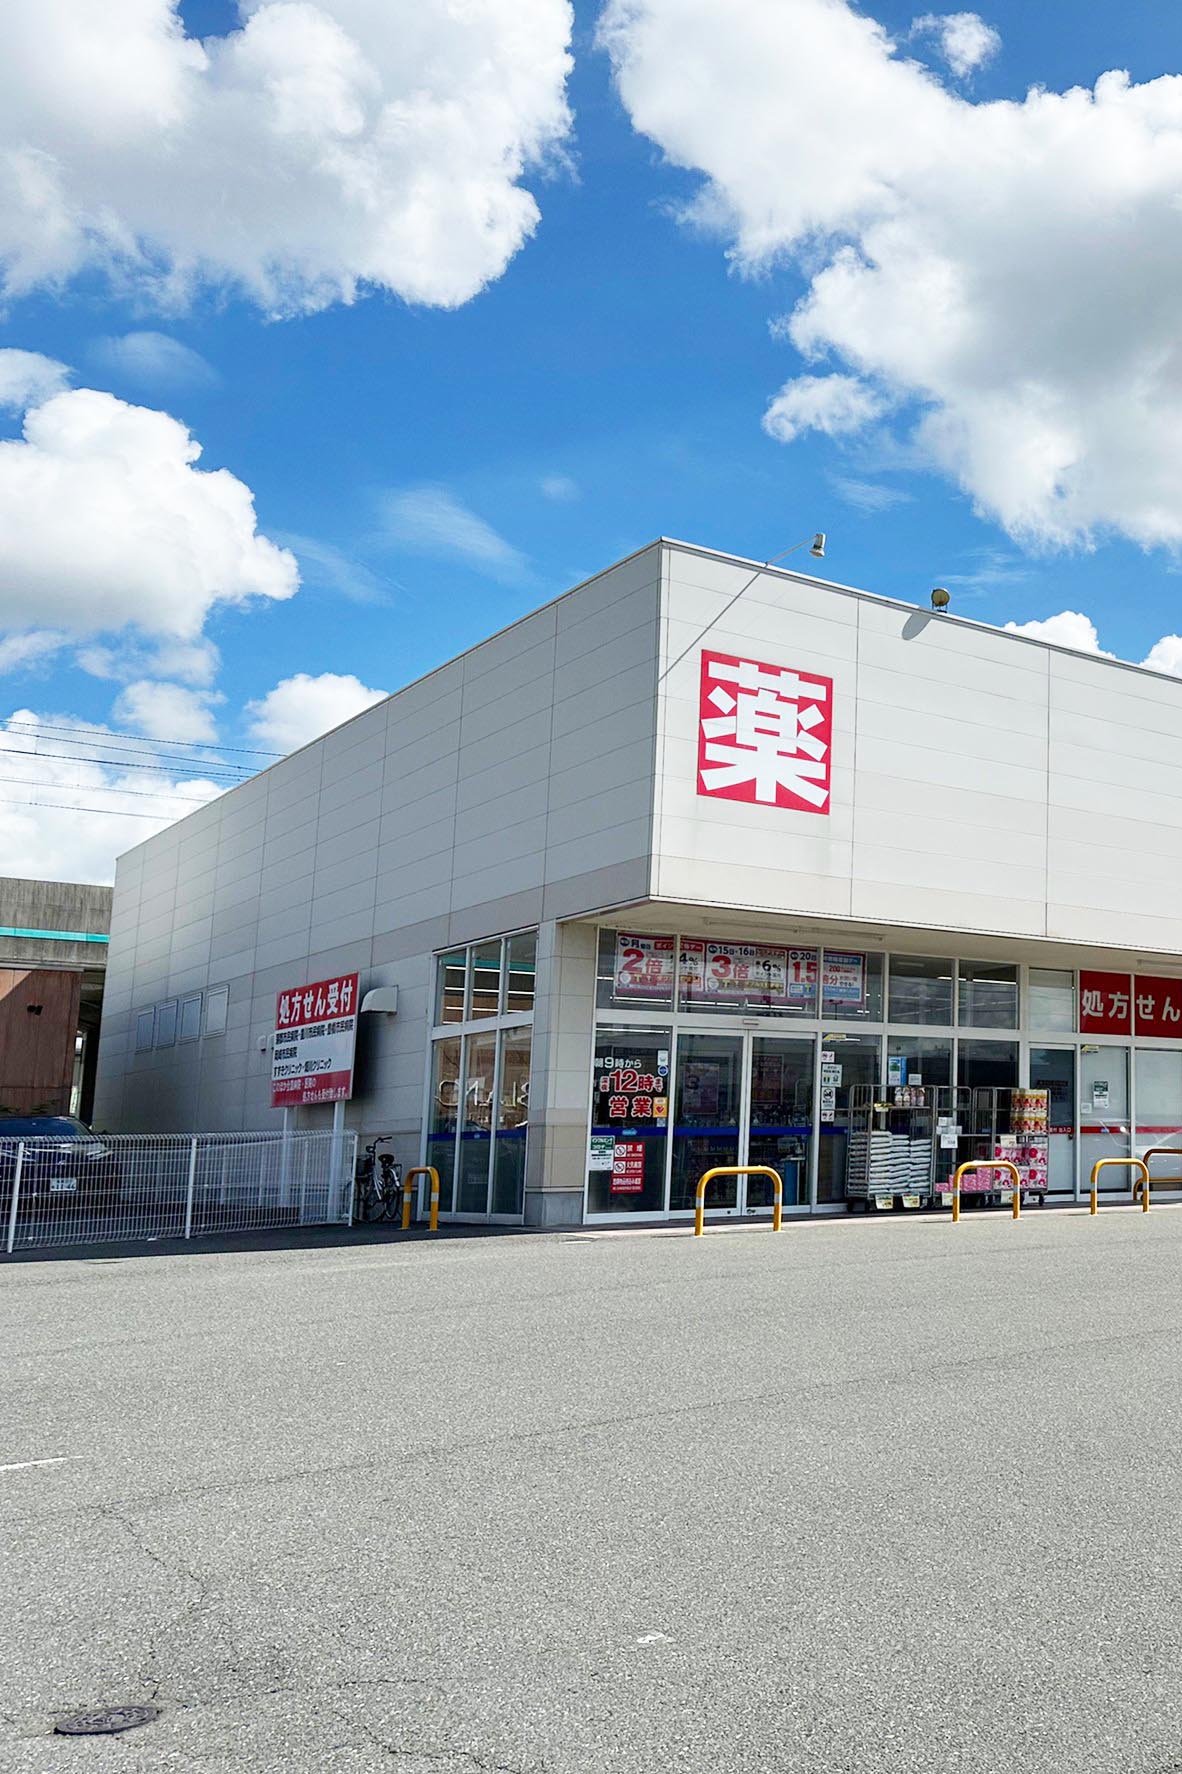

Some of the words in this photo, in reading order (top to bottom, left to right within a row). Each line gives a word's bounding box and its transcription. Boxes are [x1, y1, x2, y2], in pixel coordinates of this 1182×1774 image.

[701, 660, 829, 808] 薬
[279, 980, 353, 1024] 処方せん受付
[609, 1095, 652, 1118] 営業
